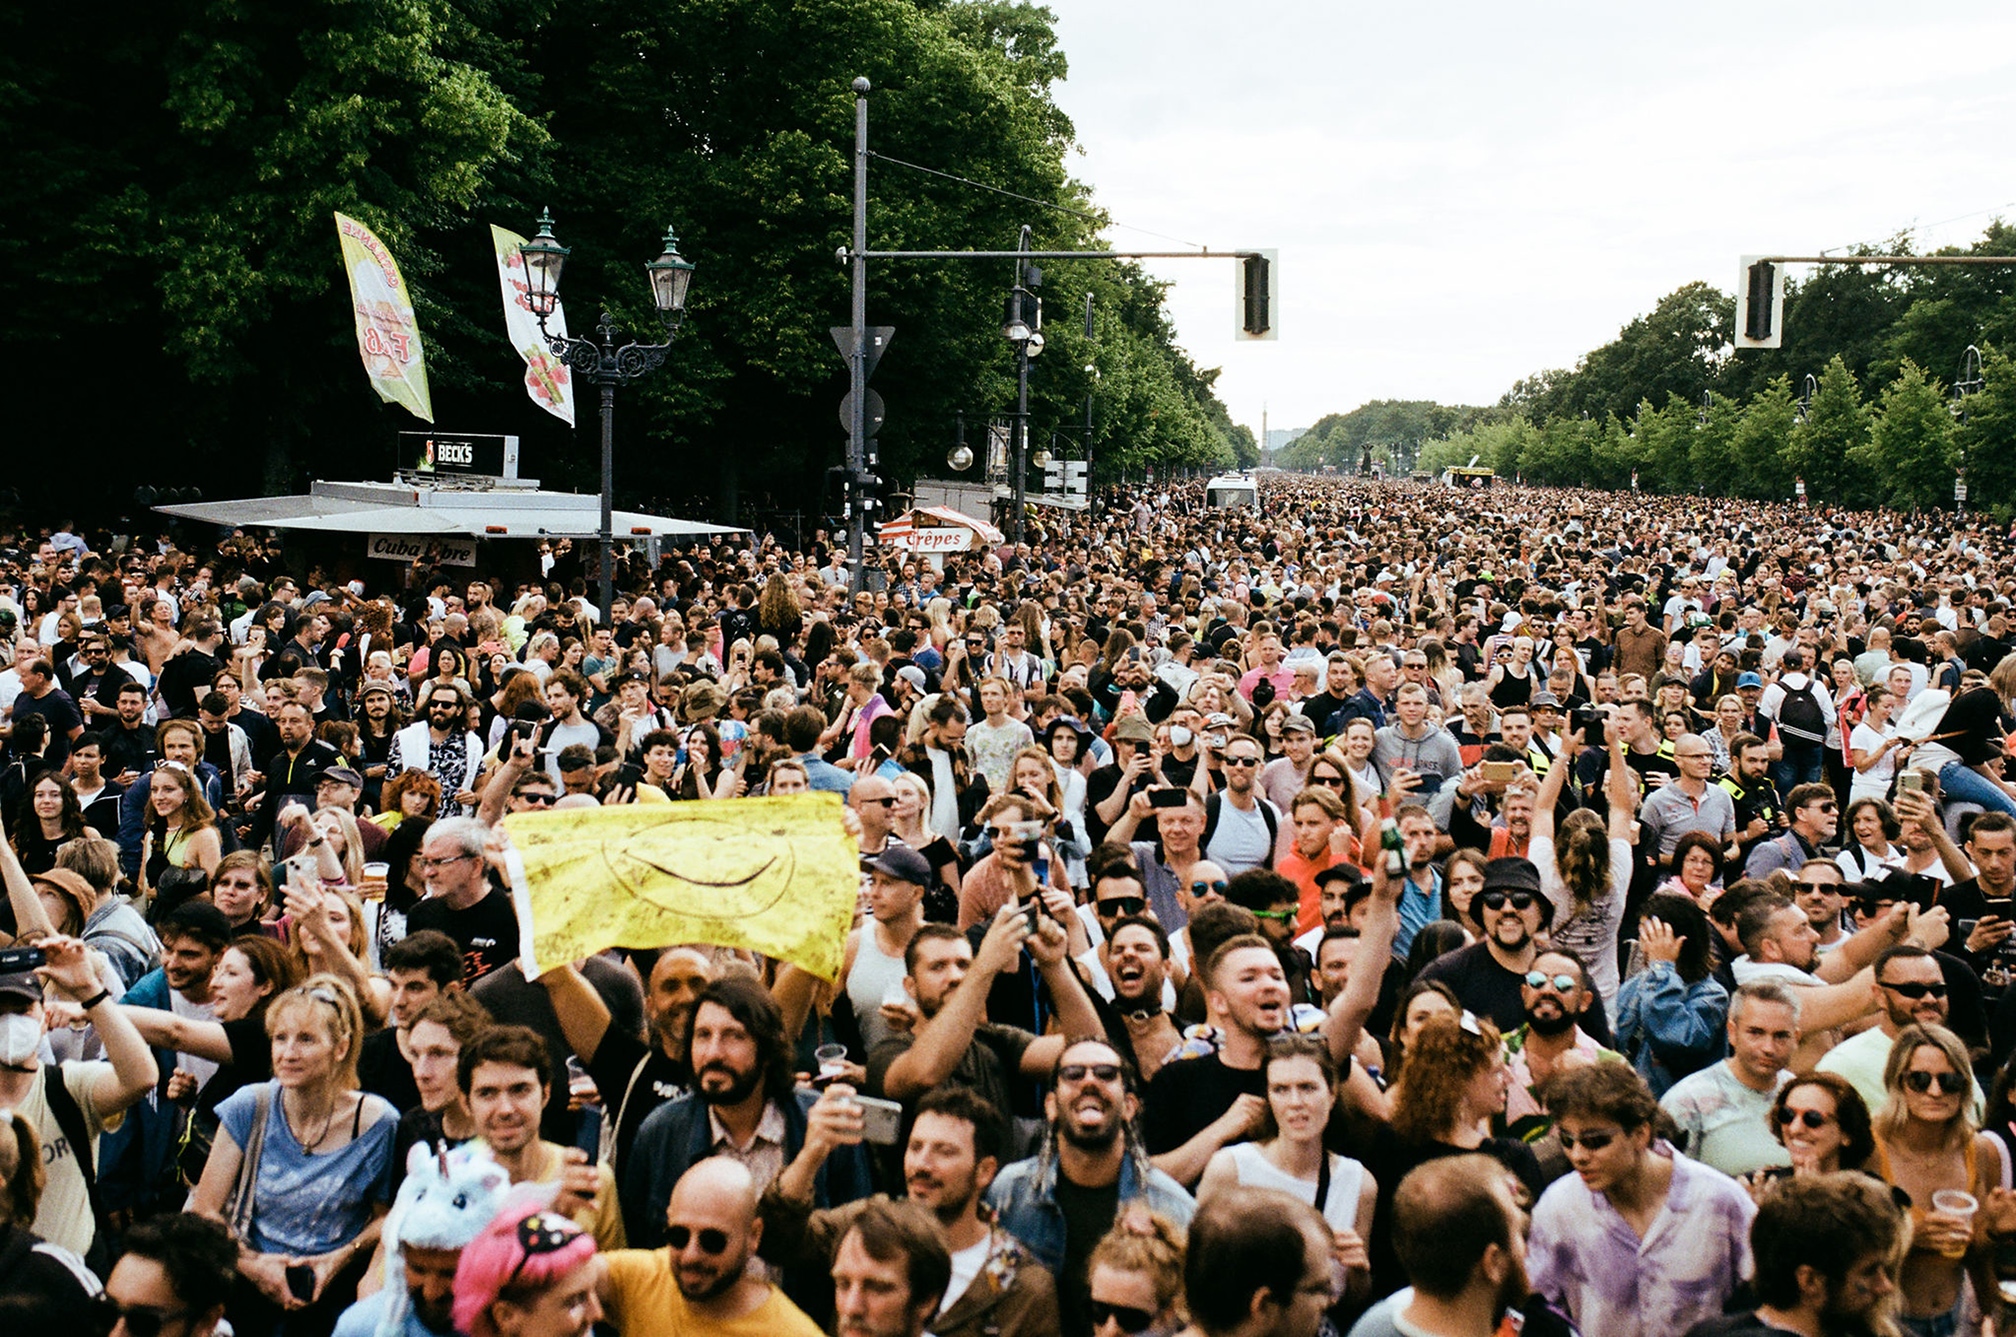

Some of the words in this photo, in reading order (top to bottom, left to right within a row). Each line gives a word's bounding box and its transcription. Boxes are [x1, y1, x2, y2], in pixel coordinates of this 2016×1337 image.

[437, 443, 473, 464] BECK'S
[373, 538, 421, 557] Cuba
[424, 543, 471, 562] Lbre
[906, 530, 962, 550] Crêpes
